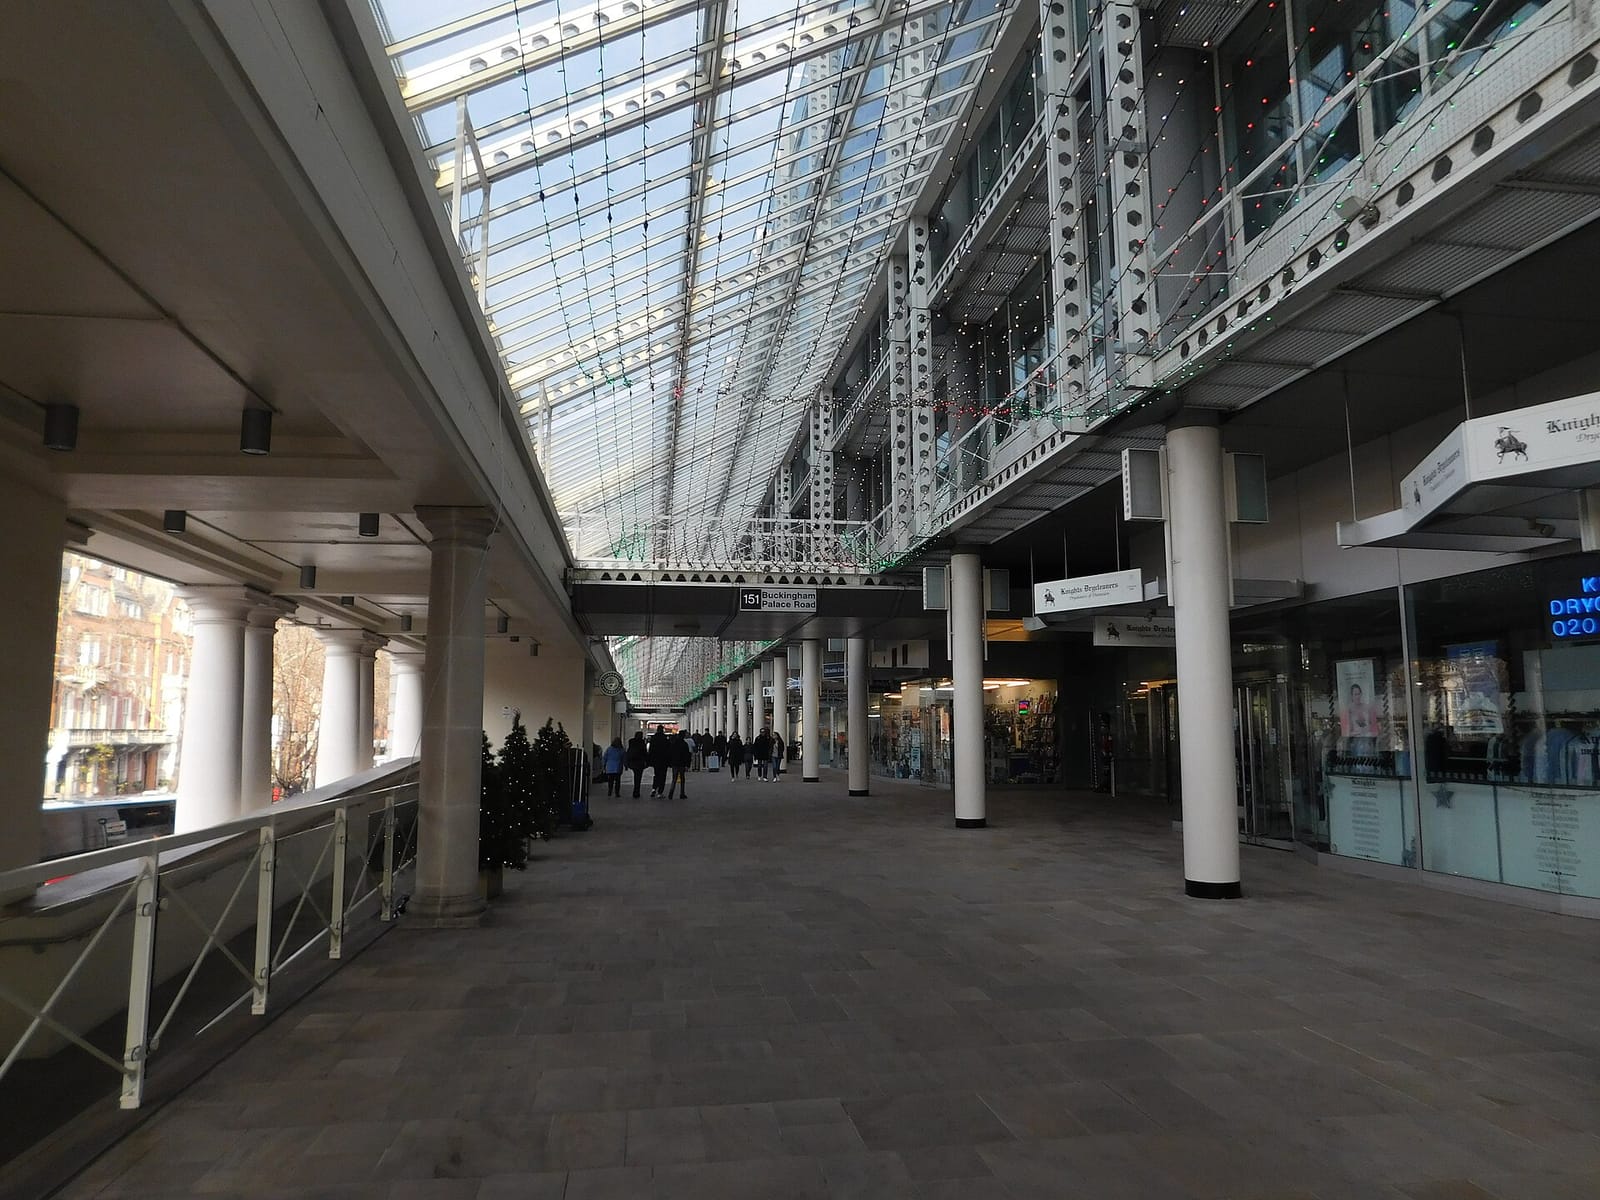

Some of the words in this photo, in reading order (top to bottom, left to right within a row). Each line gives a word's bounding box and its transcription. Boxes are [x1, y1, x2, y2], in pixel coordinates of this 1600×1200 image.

[1060, 586, 1083, 596] Knights
[1084, 581, 1119, 593] Drycleaners
[743, 593, 760, 605] 151
[762, 591, 816, 601] Buckingham
[762, 600, 791, 608] Palace
[794, 600, 816, 608] Road
[1552, 618, 1596, 637] 020
